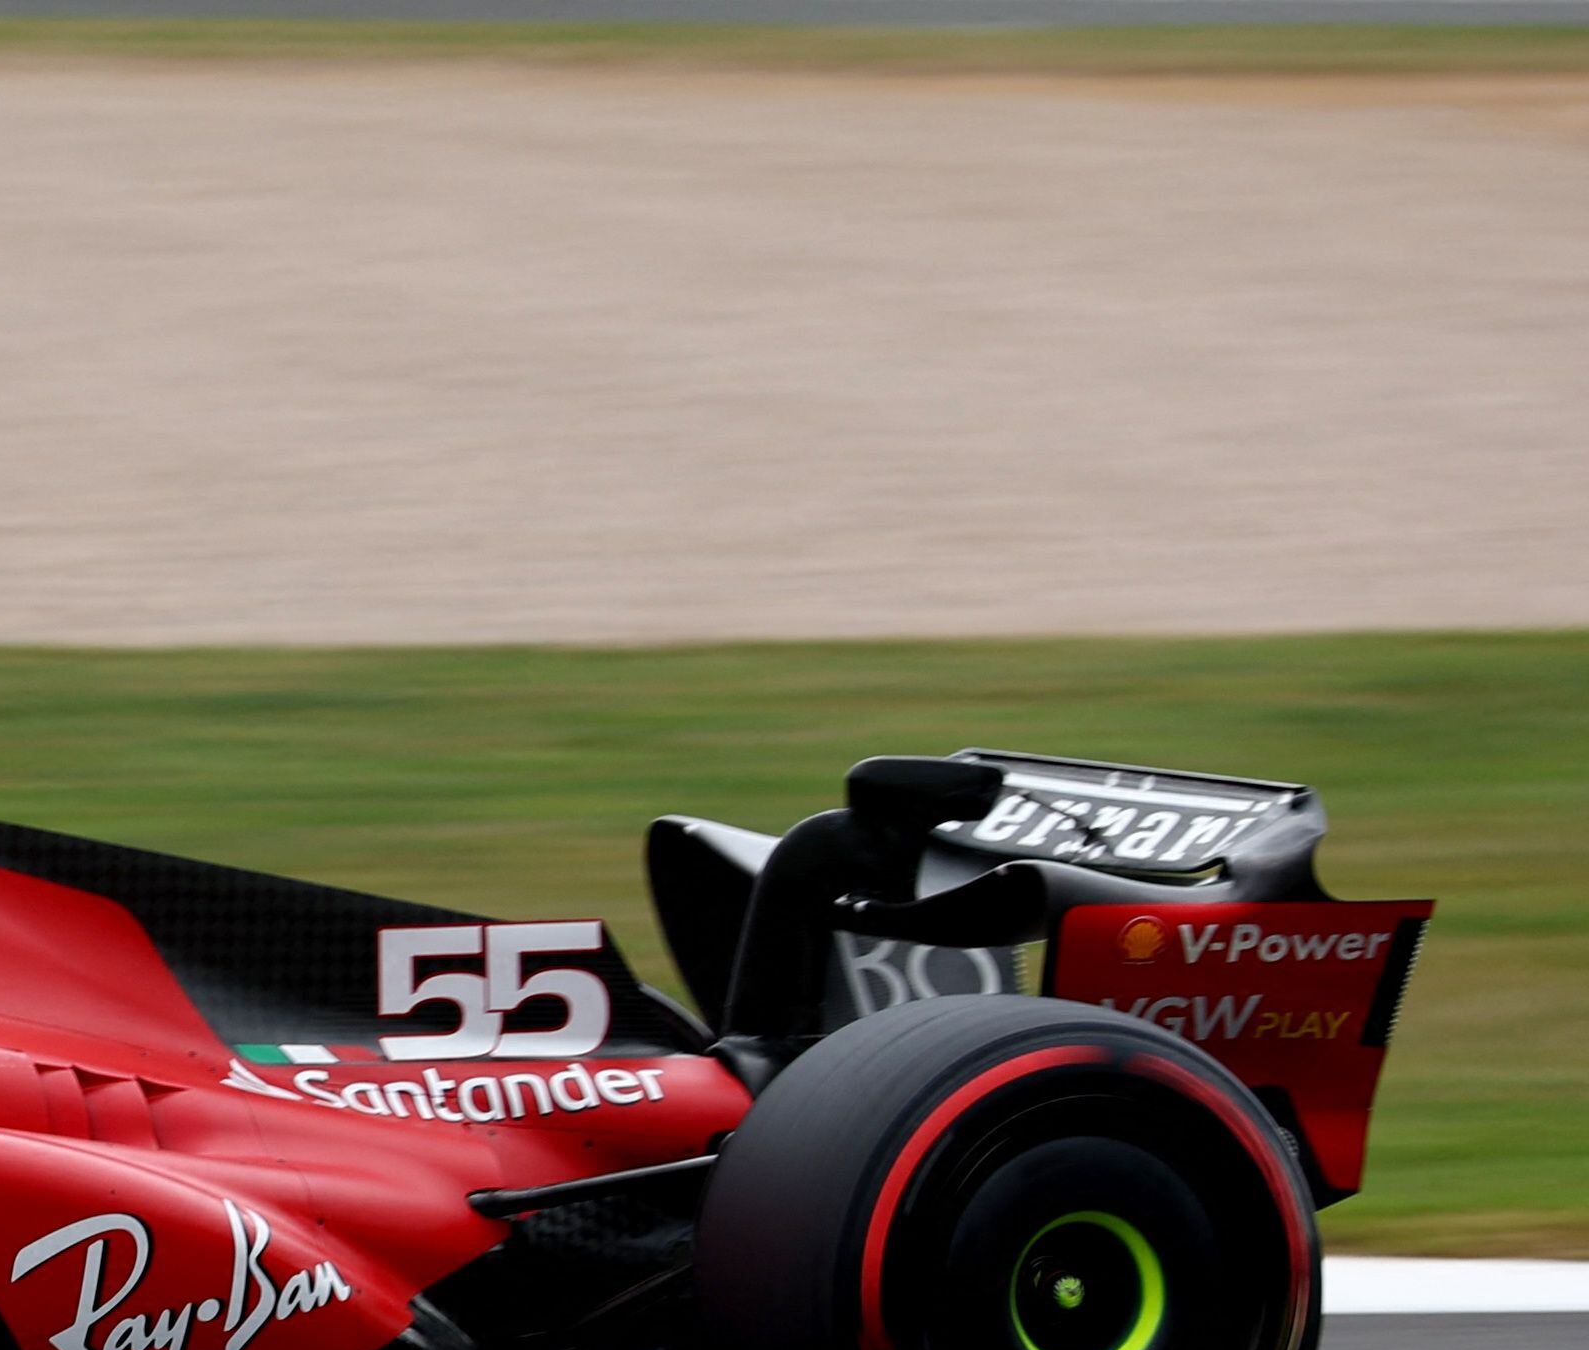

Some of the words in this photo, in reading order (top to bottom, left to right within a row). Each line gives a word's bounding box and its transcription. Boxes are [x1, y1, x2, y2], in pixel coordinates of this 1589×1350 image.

[1177, 923, 1391, 964] V-Power
[378, 918, 611, 1061] 55
[1253, 1010, 1351, 1040] PLAY
[292, 1062, 666, 1123] Santander
